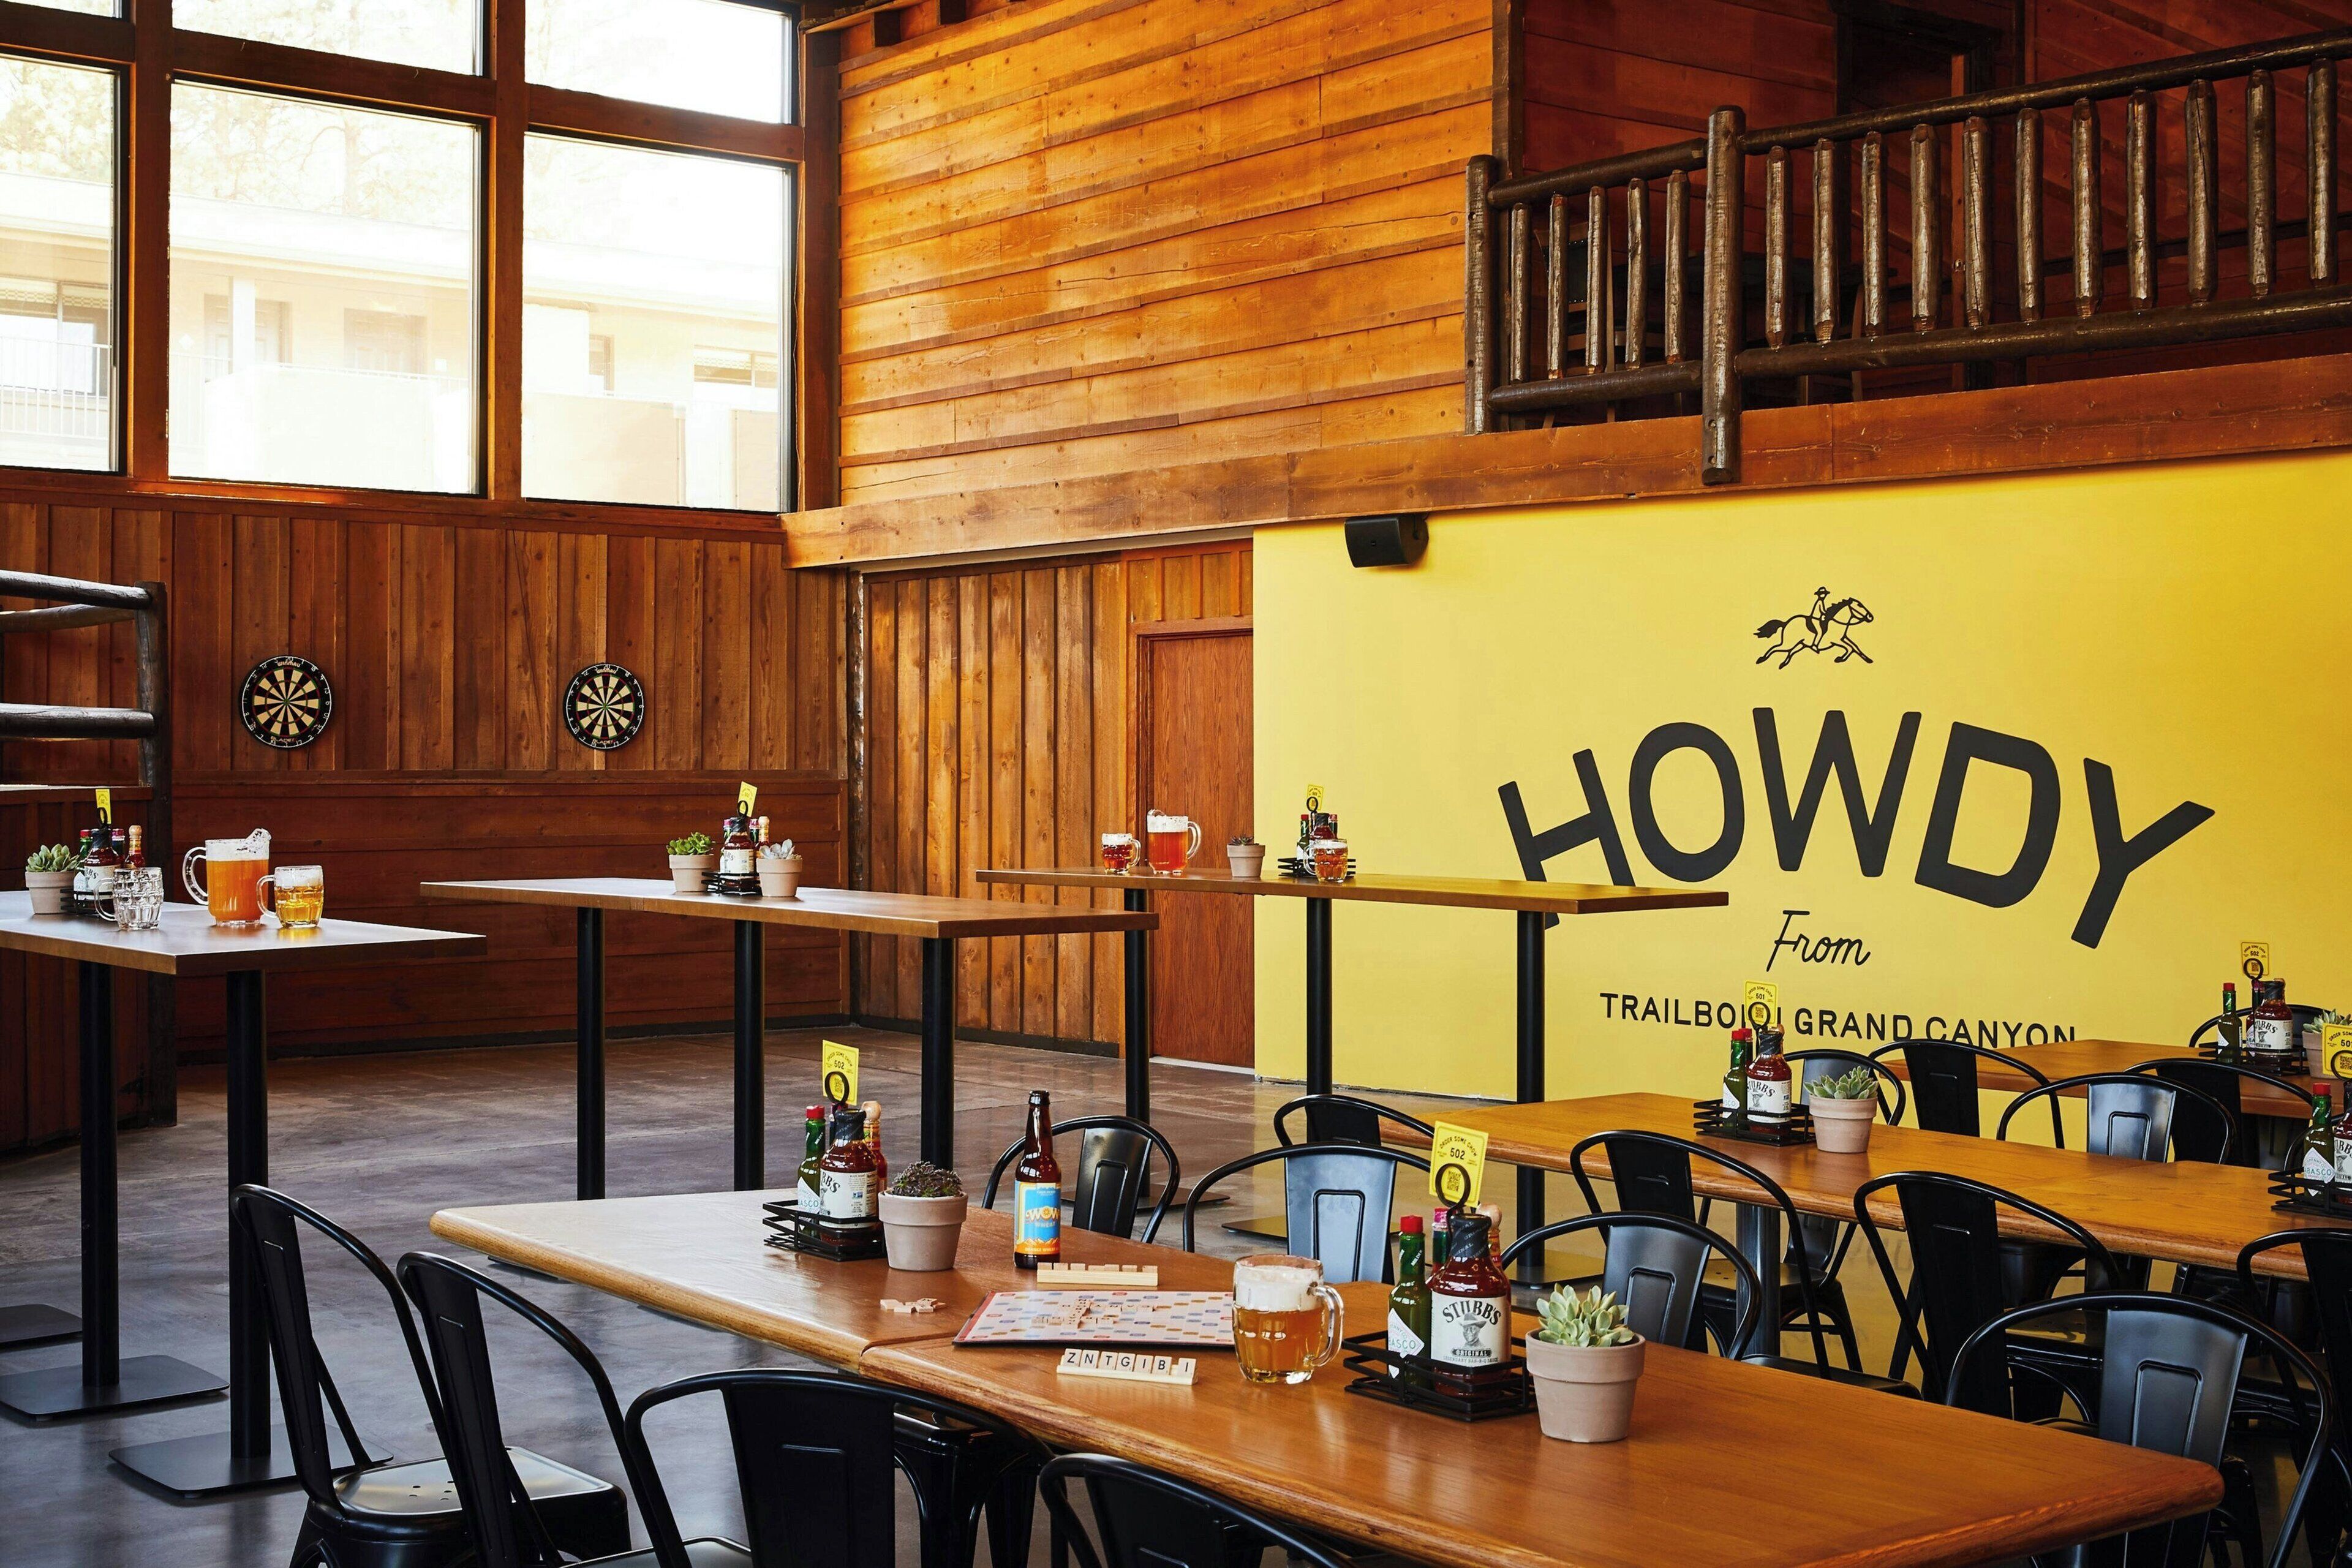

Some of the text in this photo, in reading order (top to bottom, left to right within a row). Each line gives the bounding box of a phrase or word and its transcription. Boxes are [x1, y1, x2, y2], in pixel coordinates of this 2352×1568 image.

[1498, 707, 2215, 949] HOWDY
[1766, 910, 1871, 972] From
[1795, 1008, 1913, 1041] GRAND
[1925, 1016, 2075, 1048] CANYON
[2340, 1039, 2352, 1047] 50
[834, 1060, 845, 1070] 502
[1450, 1147, 1466, 1160] 502
[1442, 1300, 1501, 1325] STUBB'S
